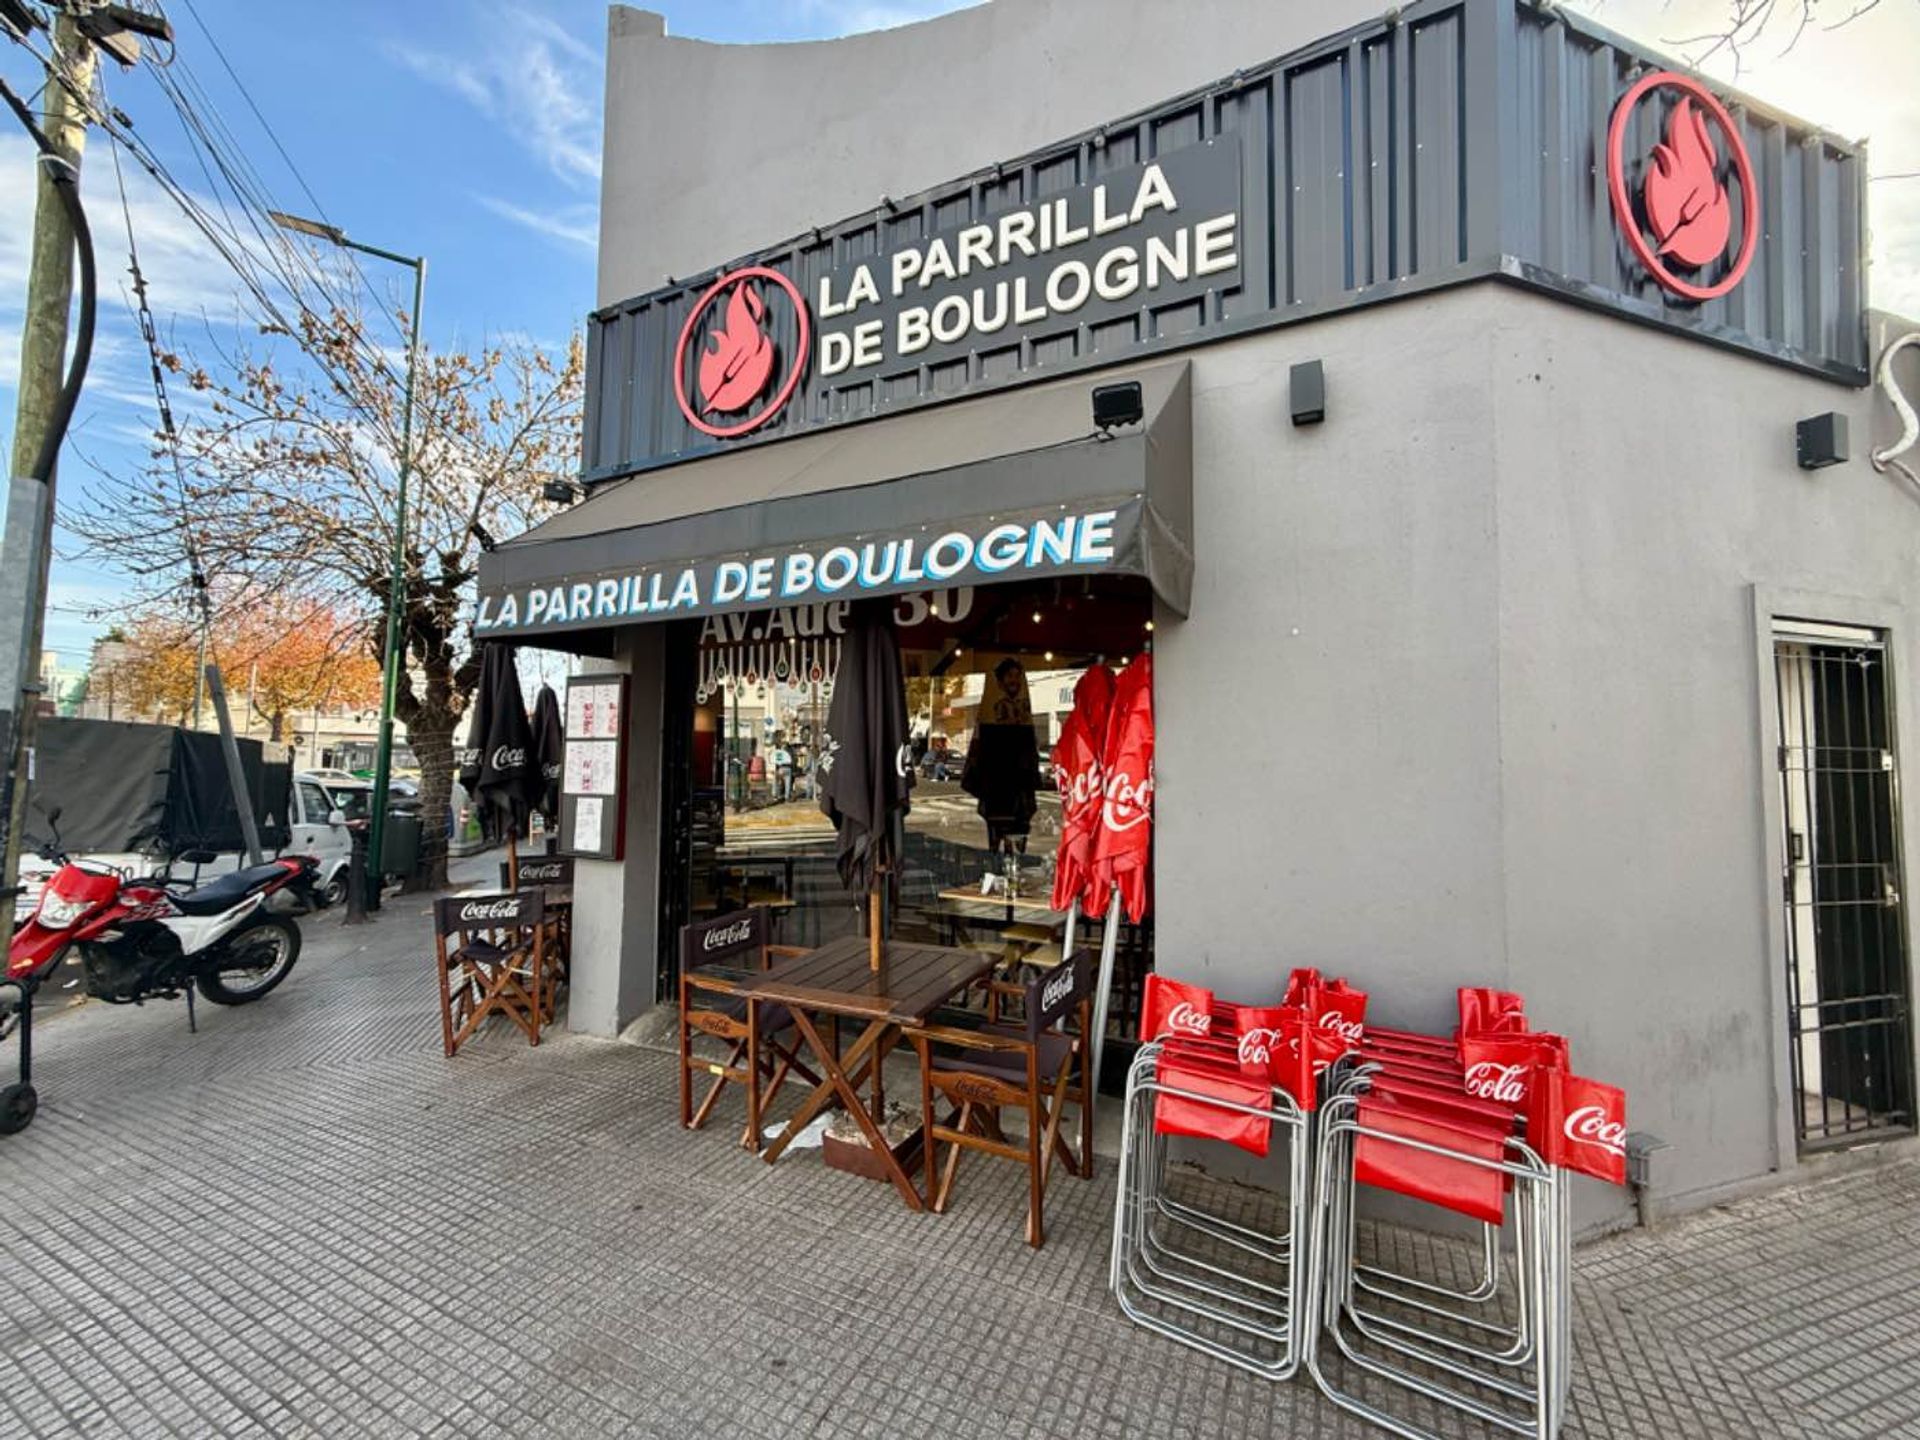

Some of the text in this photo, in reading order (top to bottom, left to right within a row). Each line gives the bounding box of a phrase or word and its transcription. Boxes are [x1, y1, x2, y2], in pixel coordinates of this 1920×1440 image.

[819, 163, 1178, 319] LA PARRILLA
[820, 212, 1239, 376] DE BOULOGNE
[476, 510, 1117, 629] LA PARRILLA DE BOULOGNE
[1102, 764, 1153, 832] Coc
[1168, 1001, 1211, 1035] Coca
[1465, 1061, 1530, 1102] Cola
